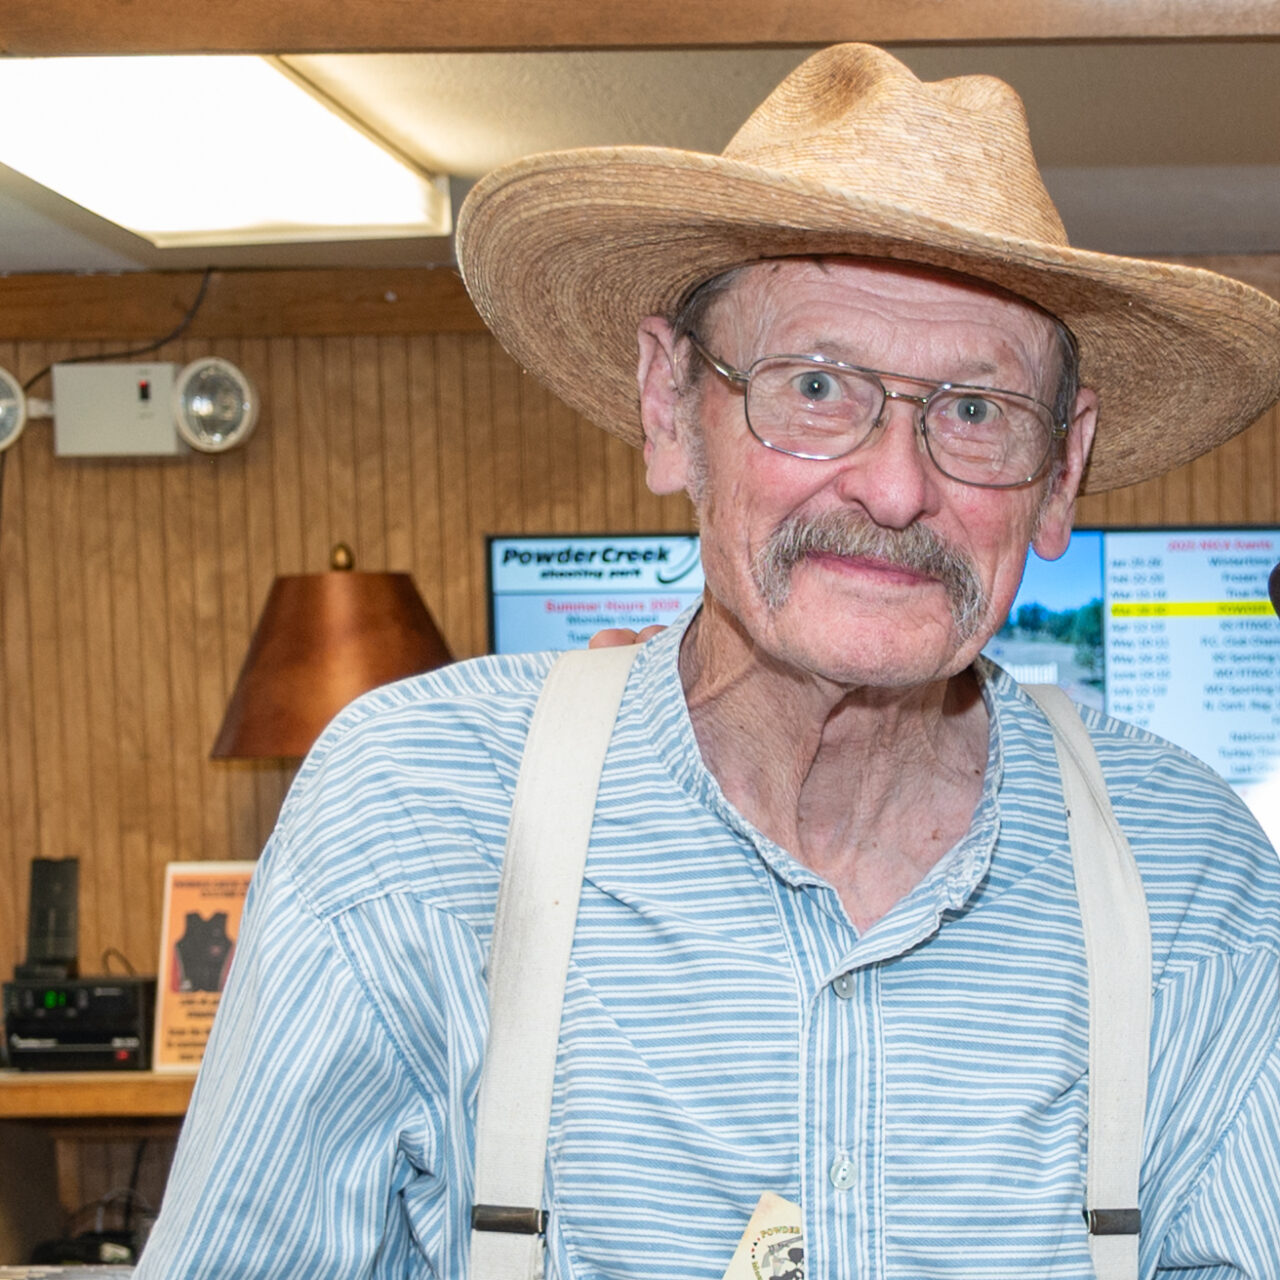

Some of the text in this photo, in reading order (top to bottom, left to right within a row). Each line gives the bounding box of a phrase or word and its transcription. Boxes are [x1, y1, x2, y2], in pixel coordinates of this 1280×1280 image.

[538, 567, 642, 580] shooting park
[544, 599, 600, 613] Summer
[604, 600, 644, 612] Hours
